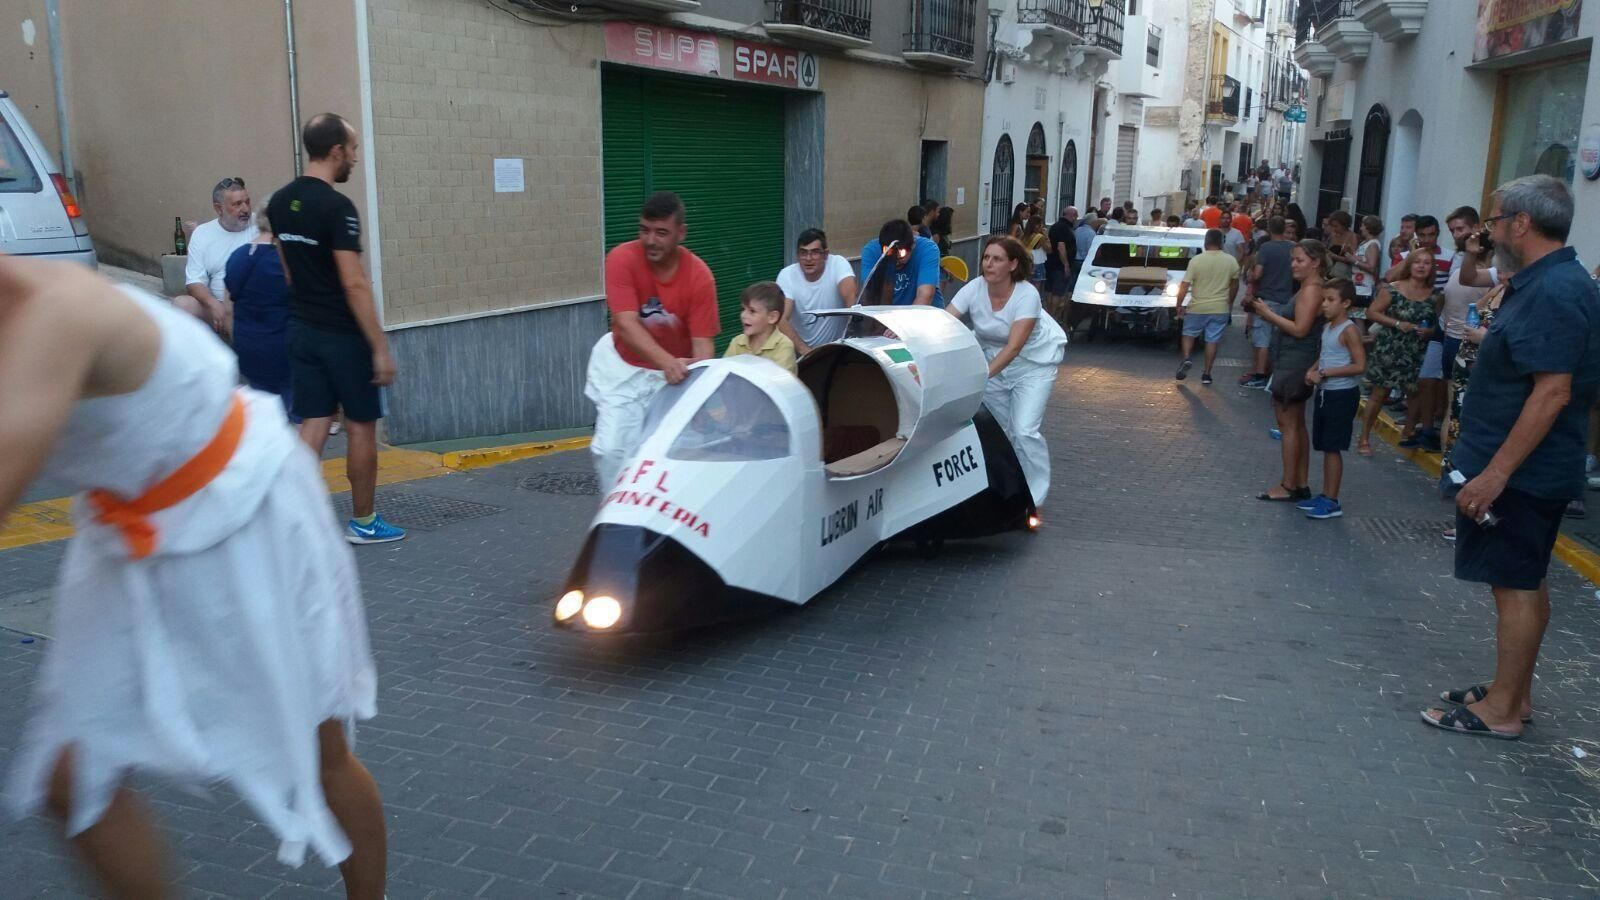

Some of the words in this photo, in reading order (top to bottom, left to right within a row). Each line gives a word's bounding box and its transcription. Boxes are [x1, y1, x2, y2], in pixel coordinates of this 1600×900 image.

[735, 46, 799, 80] SPAR
[820, 499, 859, 547] LUBRIN
[866, 488, 884, 520] AIR
[932, 445, 979, 488] FORCE
